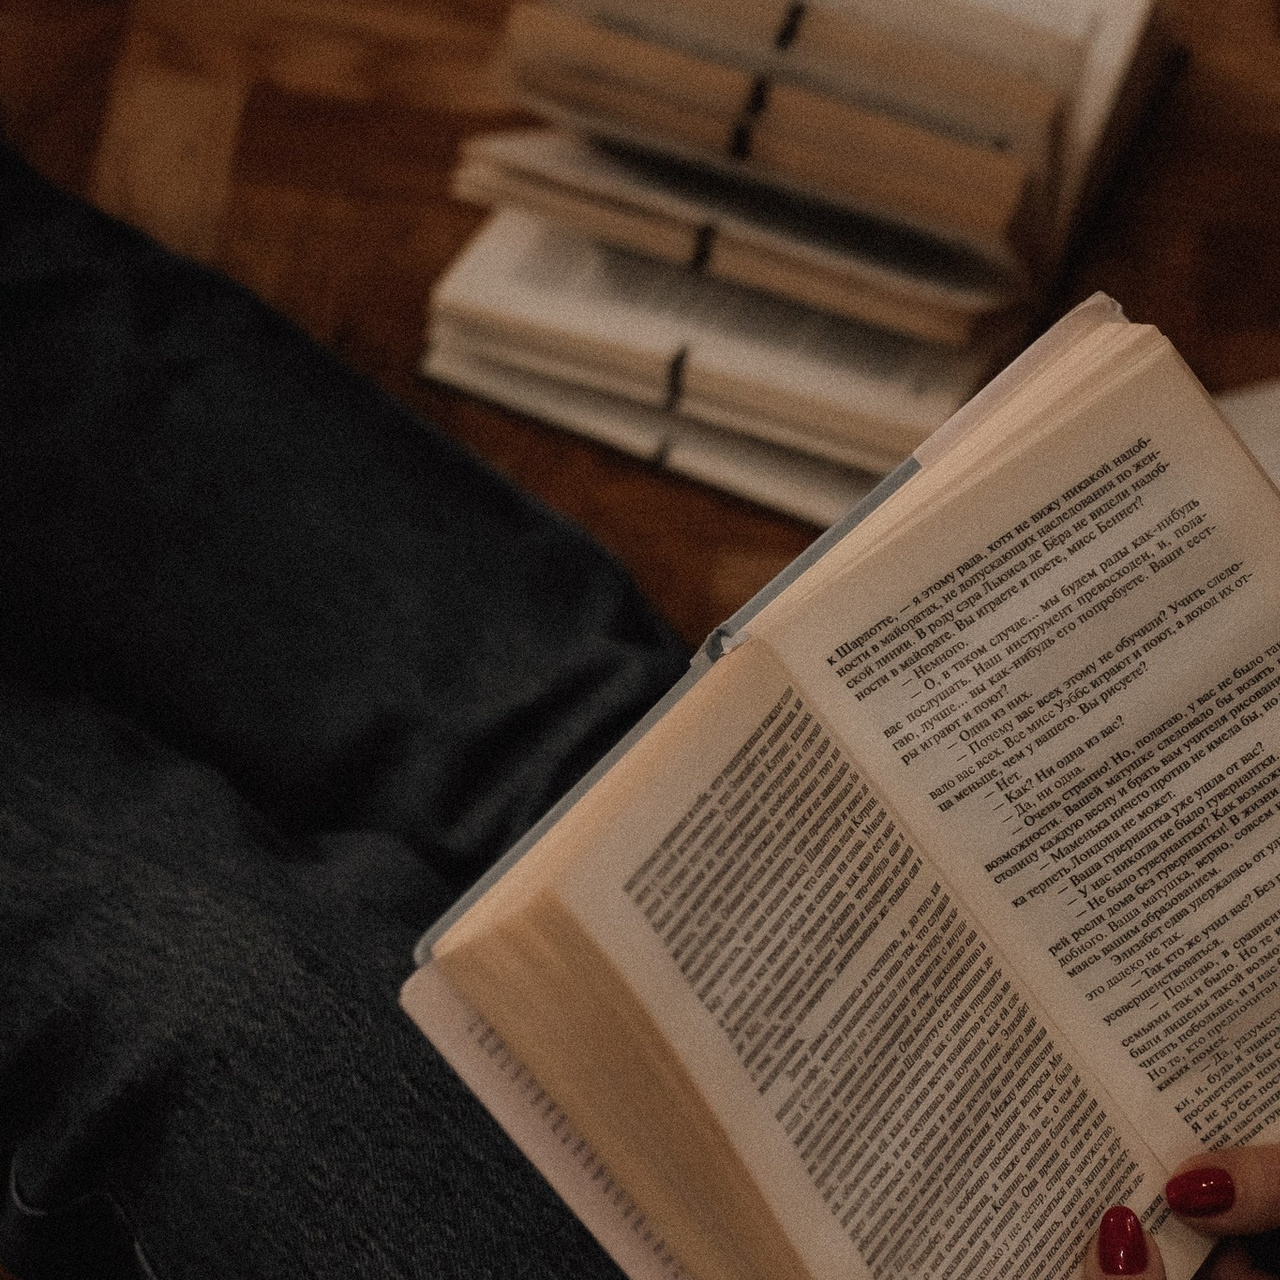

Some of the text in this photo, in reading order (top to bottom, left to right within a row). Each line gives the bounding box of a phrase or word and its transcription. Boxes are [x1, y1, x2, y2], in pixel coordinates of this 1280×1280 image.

[833, 615, 899, 659] Шарлотте,
[920, 570, 956, 599] этому
[954, 552, 988, 577] рада,
[986, 530, 1015, 554] хотя
[1013, 519, 1031, 535] не
[1029, 497, 1061, 524] вижу
[1060, 462, 1113, 502] никакой
[1111, 436, 1151, 467] надоб-
[835, 649, 871, 678] ности
[878, 602, 943, 647] майоратах,
[940, 588, 958, 604] не
[957, 533, 1037, 594] допускающих
[1035, 479, 1116, 538] наследования
[1114, 468, 1132, 484] по
[1131, 450, 1161, 473] жен-
[845, 664, 875, 689] ской
[874, 639, 916, 670] линии.
[926, 608, 955, 635] роду
[955, 591, 983, 613] сэра
[980, 559, 1028, 595] Льюиса
[1027, 549, 1043, 564] де
[1041, 528, 1072, 552] Бёра
[1071, 517, 1088, 532] не
[1087, 488, 1131, 521] видели
[1130, 460, 1170, 492] надоб-
[853, 673, 890, 702] ности
[898, 630, 956, 671] майорате.
[953, 614, 976, 632] Вы
[974, 584, 1019, 619] играете
[1028, 554, 1067, 581] поете,
[1065, 530, 1097, 555] мисс
[1094, 494, 1144, 534] Беннет?
[891, 525, 1216, 751] гаю, лучше... вы как-нибудь его попробуете. Ваши сест-
[950, 644, 988, 672] таком
[988, 614, 1039, 647] случае...
[1039, 593, 1060, 612] мы
[1059, 567, 1098, 597] будем
[1098, 545, 1130, 573] рады
[1130, 498, 1200, 549] как-нибудь
[911, 640, 969, 679] Немного.
[936, 798, 955, 812] ца
[952, 768, 1003, 802] меньше,
[1001, 749, 1026, 768] чем
[1033, 714, 1080, 747] вашего.
[1076, 697, 1100, 715] Вы
[1098, 660, 1148, 704] рисуете?
[967, 560, 1243, 755] Почему вас всех этому не обучили? Учить следо-
[994, 771, 1022, 792] Нет.
[1003, 714, 1124, 804] Как? Ни одна из вас?
[1013, 766, 1085, 818] Да, ни одна.
